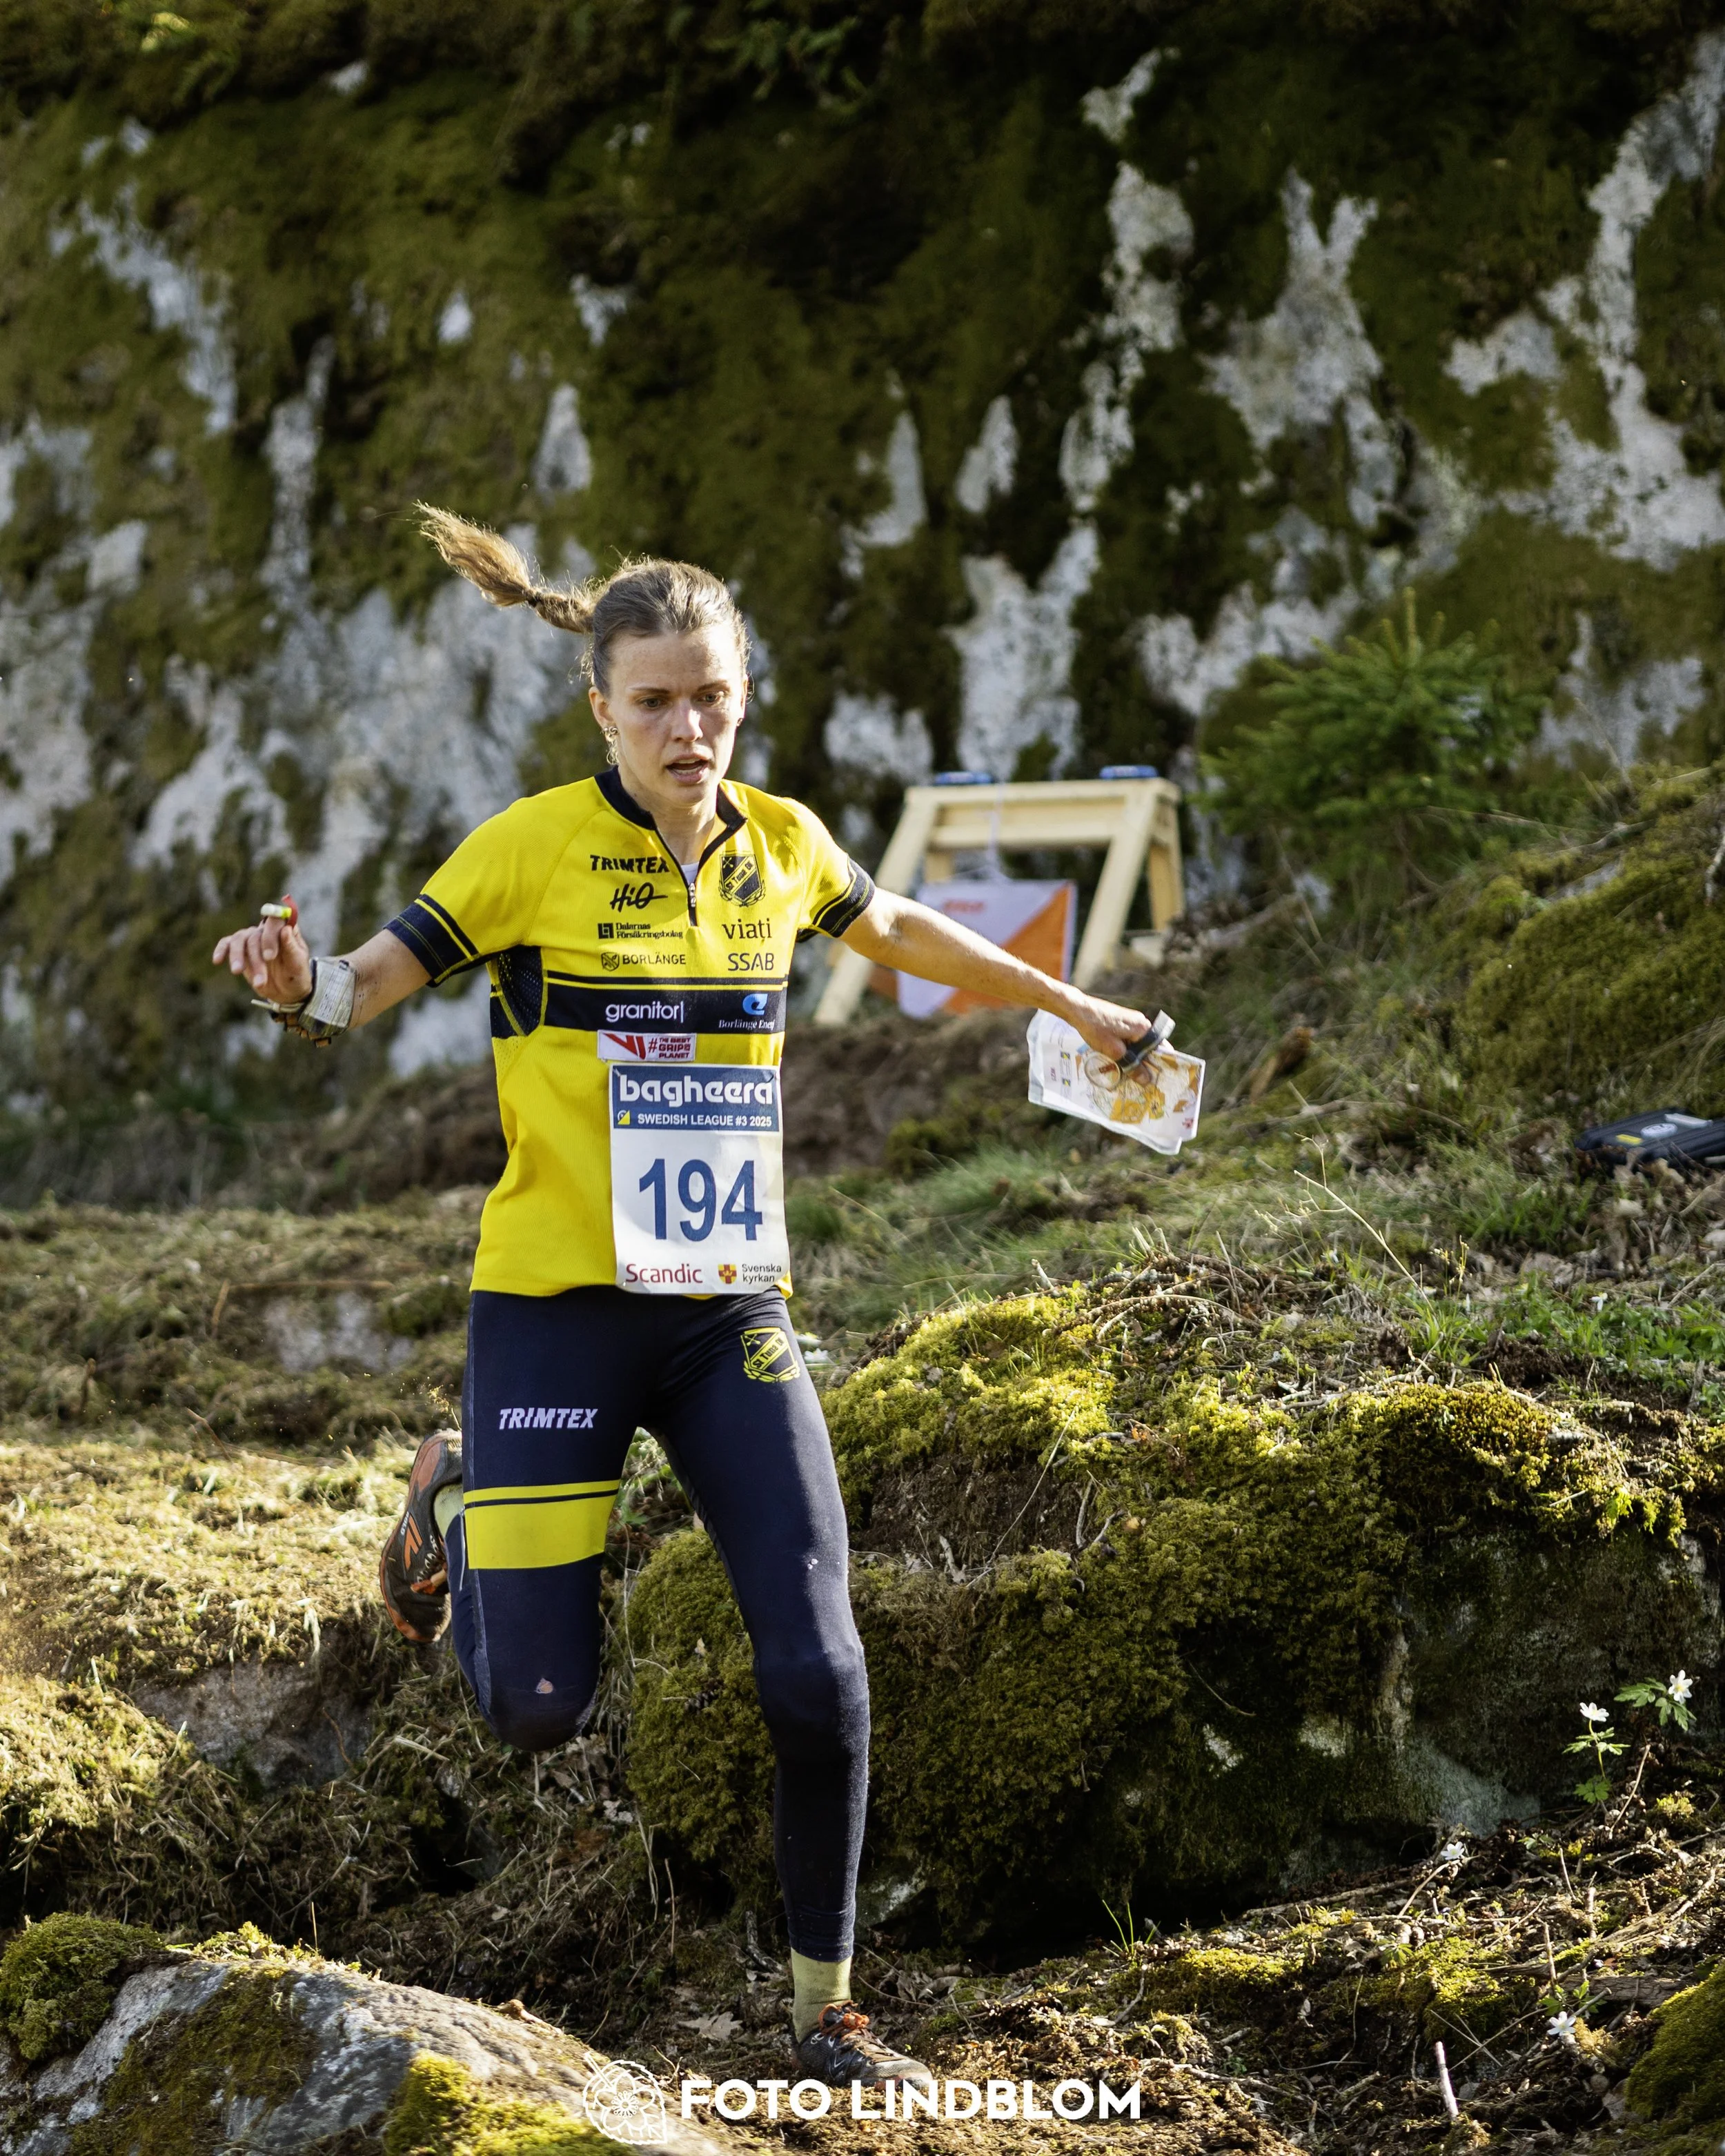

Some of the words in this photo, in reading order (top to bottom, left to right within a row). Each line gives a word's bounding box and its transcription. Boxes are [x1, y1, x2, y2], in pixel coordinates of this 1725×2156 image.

[590, 854, 669, 874] TRIMTEX
[609, 882, 669, 913] HiQ
[722, 918, 772, 939] viati
[622, 951, 686, 965] BORLÄNGE
[728, 953, 774, 971] SSAB
[718, 1018, 758, 1030] Borlänge
[620, 1074, 773, 1107] bagheera
[638, 1113, 688, 1125] SWEDISH
[691, 1114, 733, 1126] LEAGUE
[735, 1115, 748, 1126] #3
[749, 1115, 772, 1127] 2025
[639, 1158, 762, 1242] 194
[626, 1264, 703, 1283] Scandic
[742, 1263, 782, 1272] Svenska
[742, 1273, 775, 1285] kyrkan
[760, 1345, 778, 1360] Tuna
[499, 1407, 598, 1430] TRIMTEX
